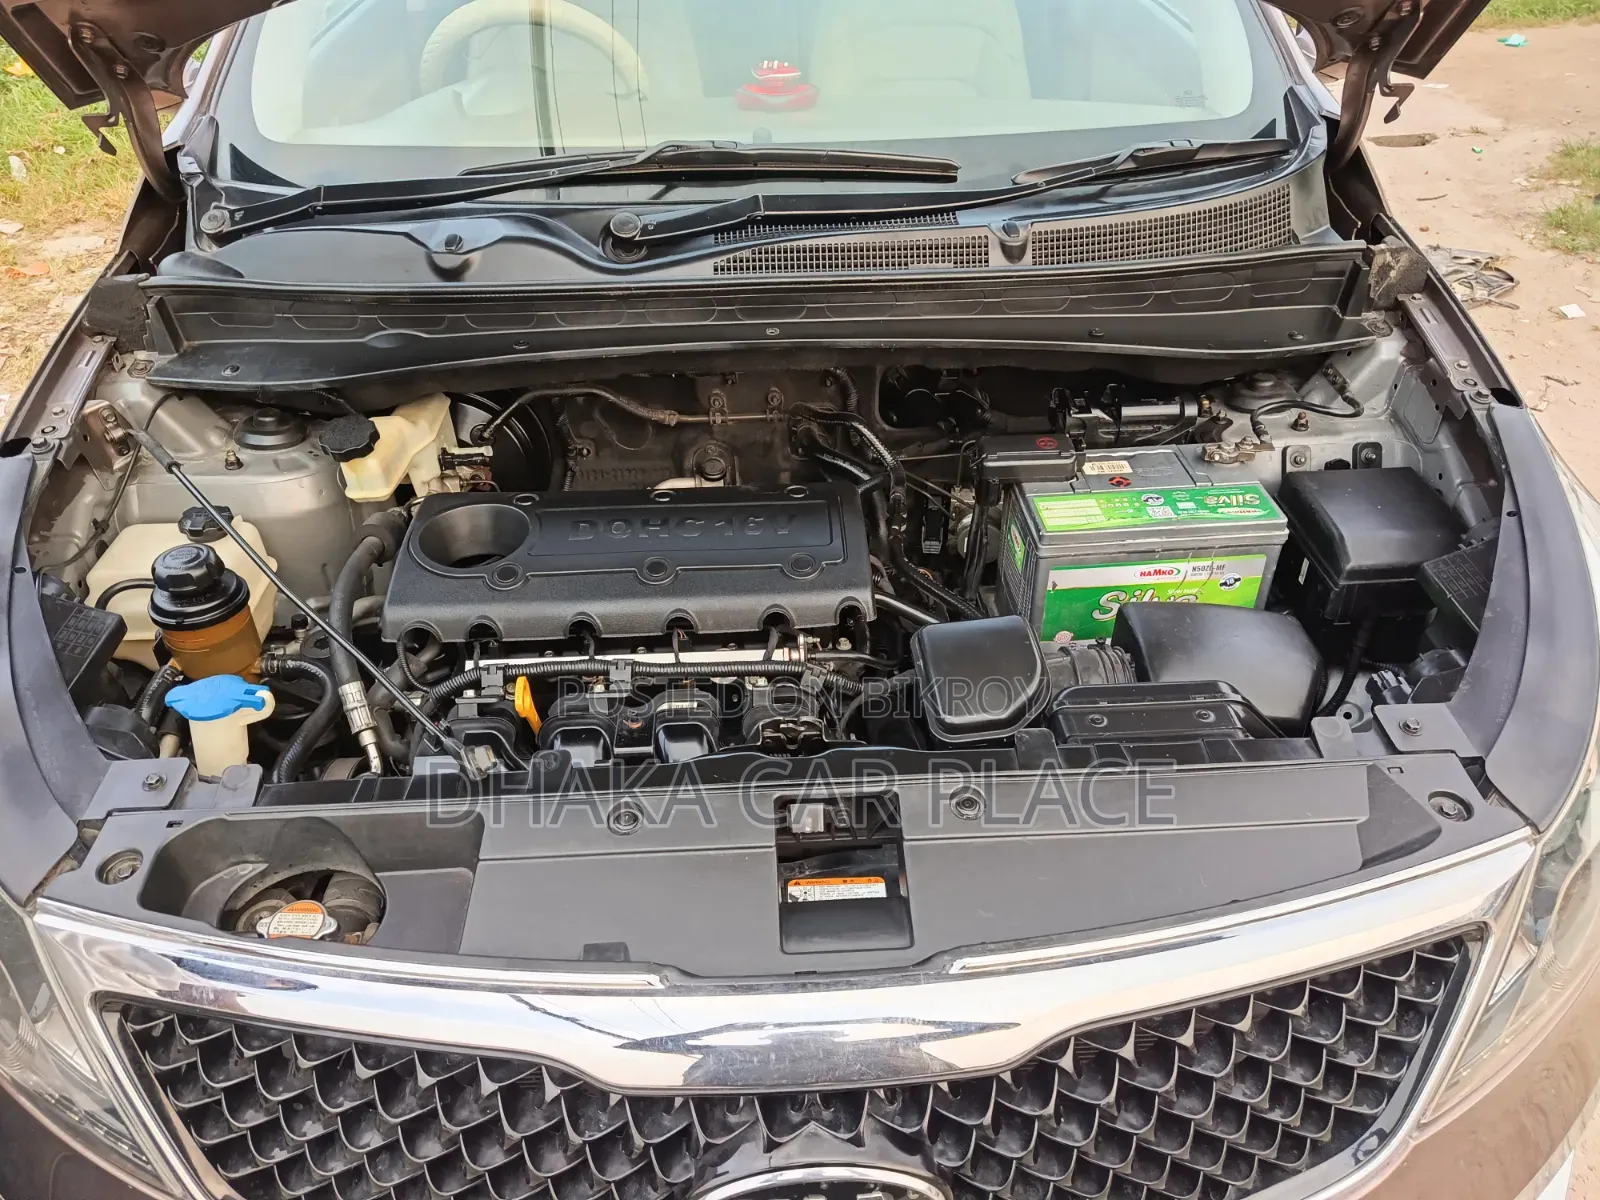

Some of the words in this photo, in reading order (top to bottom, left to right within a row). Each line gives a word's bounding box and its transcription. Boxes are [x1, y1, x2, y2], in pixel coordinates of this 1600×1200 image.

[1204, 493, 1261, 506] Silva
[568, 516, 704, 541] DOHC
[714, 512, 798, 537] 16V
